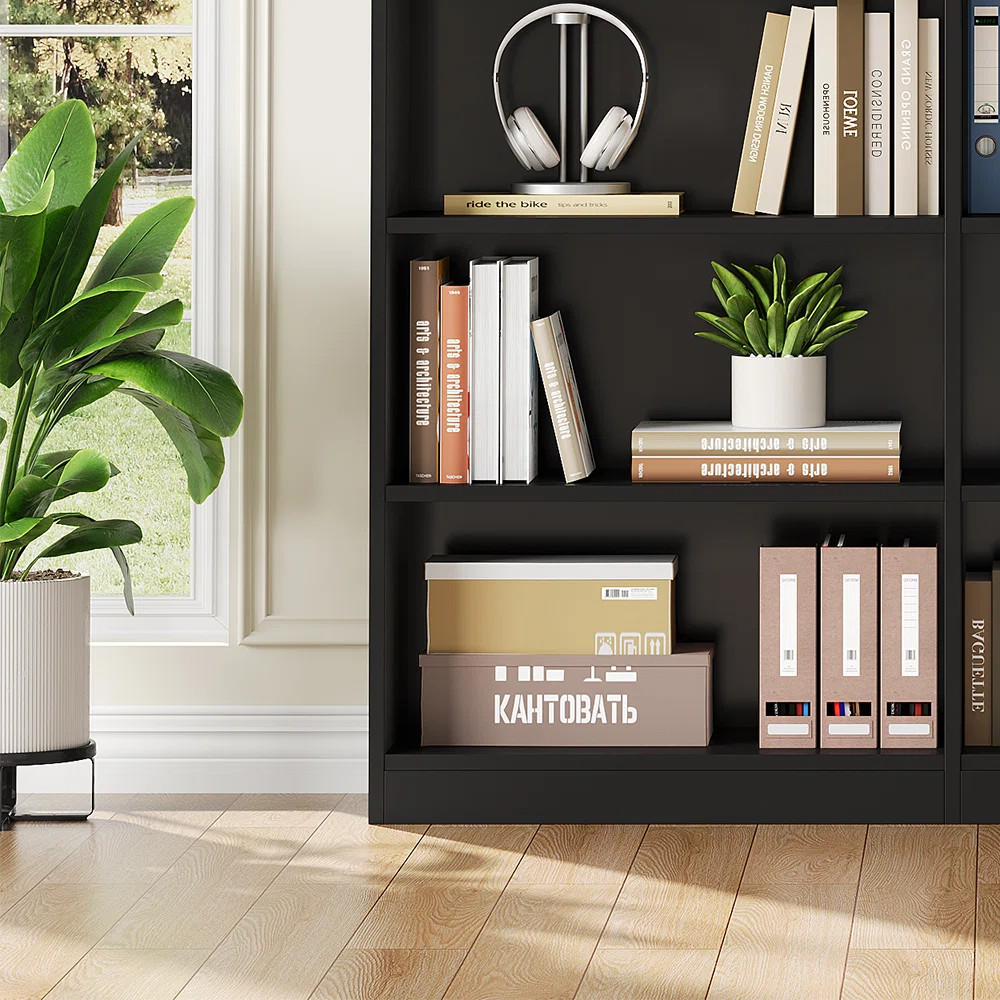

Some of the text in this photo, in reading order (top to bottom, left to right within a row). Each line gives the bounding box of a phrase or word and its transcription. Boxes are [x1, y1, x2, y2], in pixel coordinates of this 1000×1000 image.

[466, 200, 548, 208] ride the bike
[416, 320, 433, 427] arts architecture
[446, 338, 464, 433] arts architecture
[544, 361, 571, 441] arts architecture
[701, 437, 828, 453] arts architecture
[701, 463, 828, 479] arts architecture
[494, 694, 637, 724] КАНТОВАТЬ
